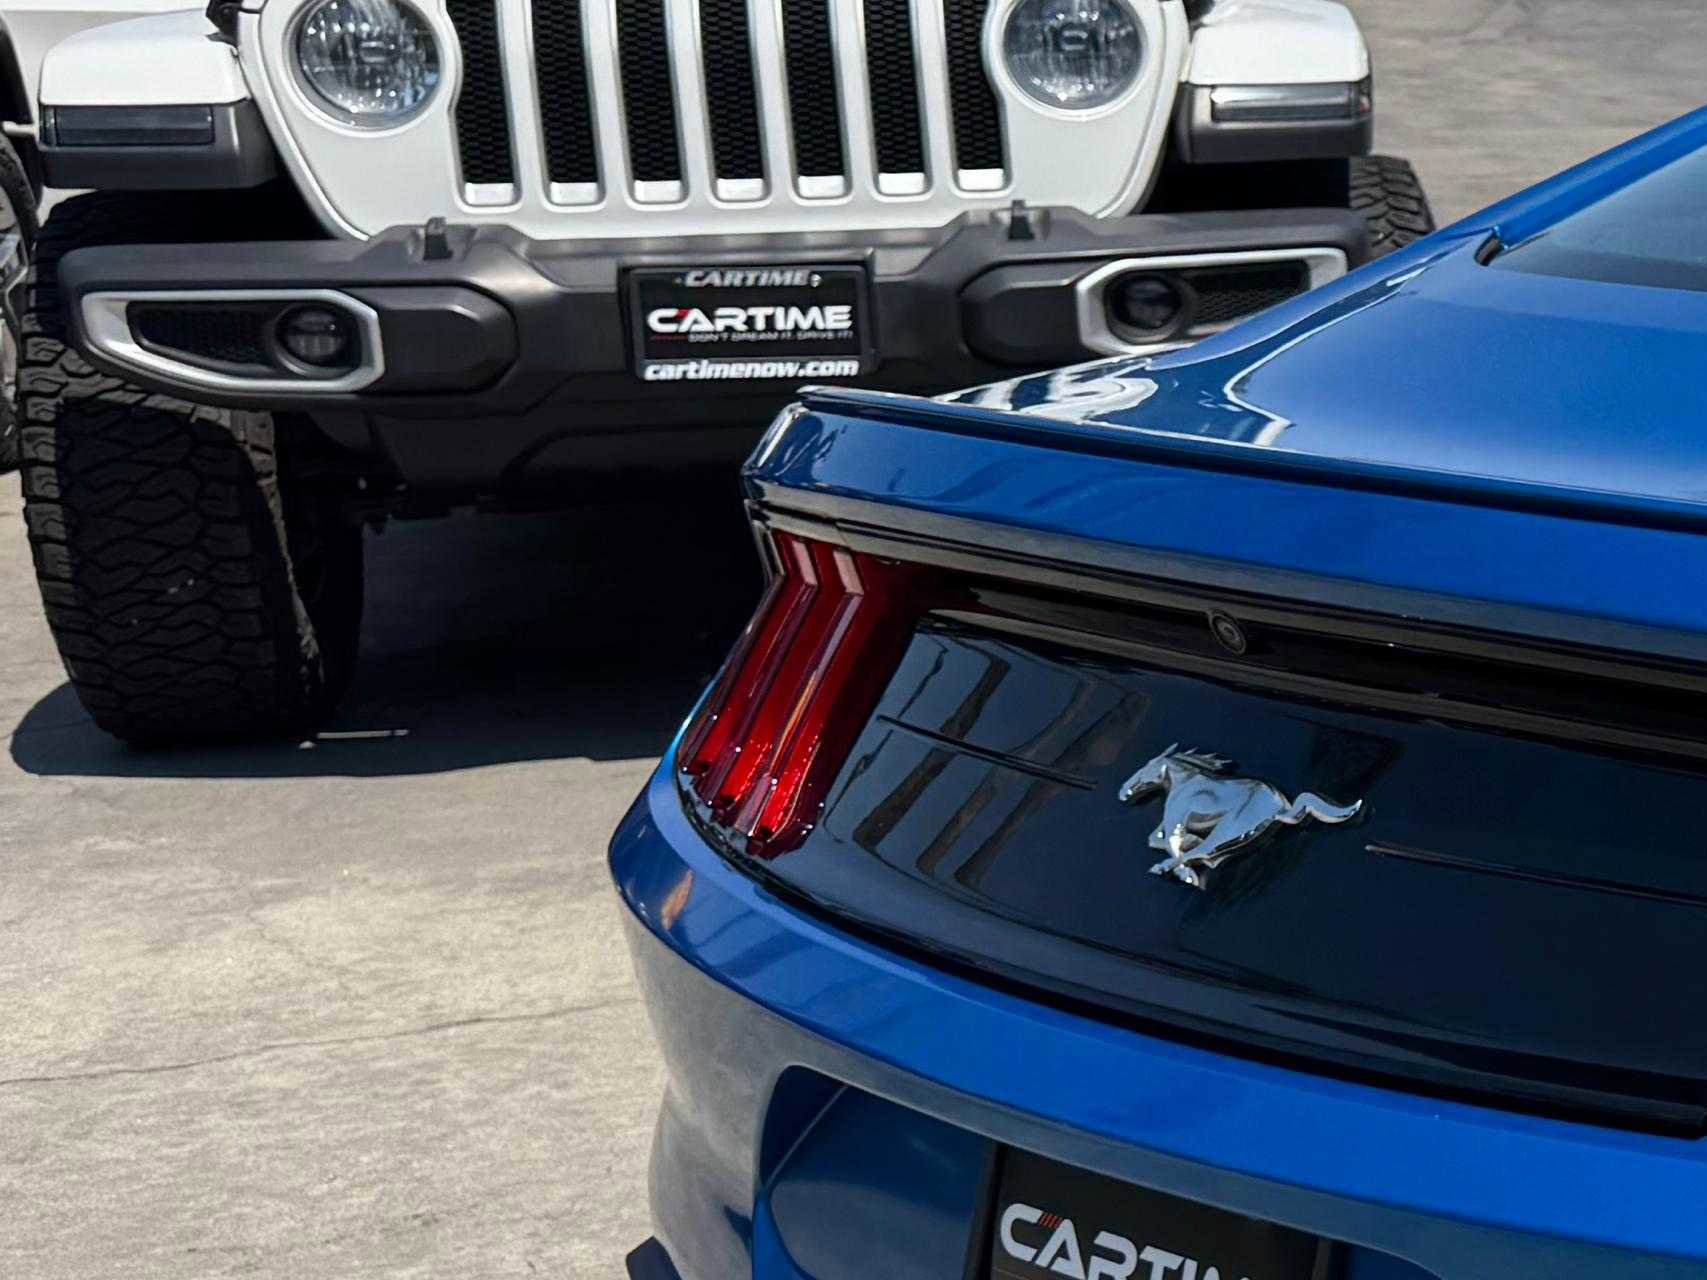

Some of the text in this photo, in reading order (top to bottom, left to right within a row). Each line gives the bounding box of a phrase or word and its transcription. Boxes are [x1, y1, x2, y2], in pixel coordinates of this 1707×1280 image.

[685, 270, 808, 288] CARTIME
[646, 305, 853, 333] CARTIME
[644, 358, 860, 381] cartimenow.com
